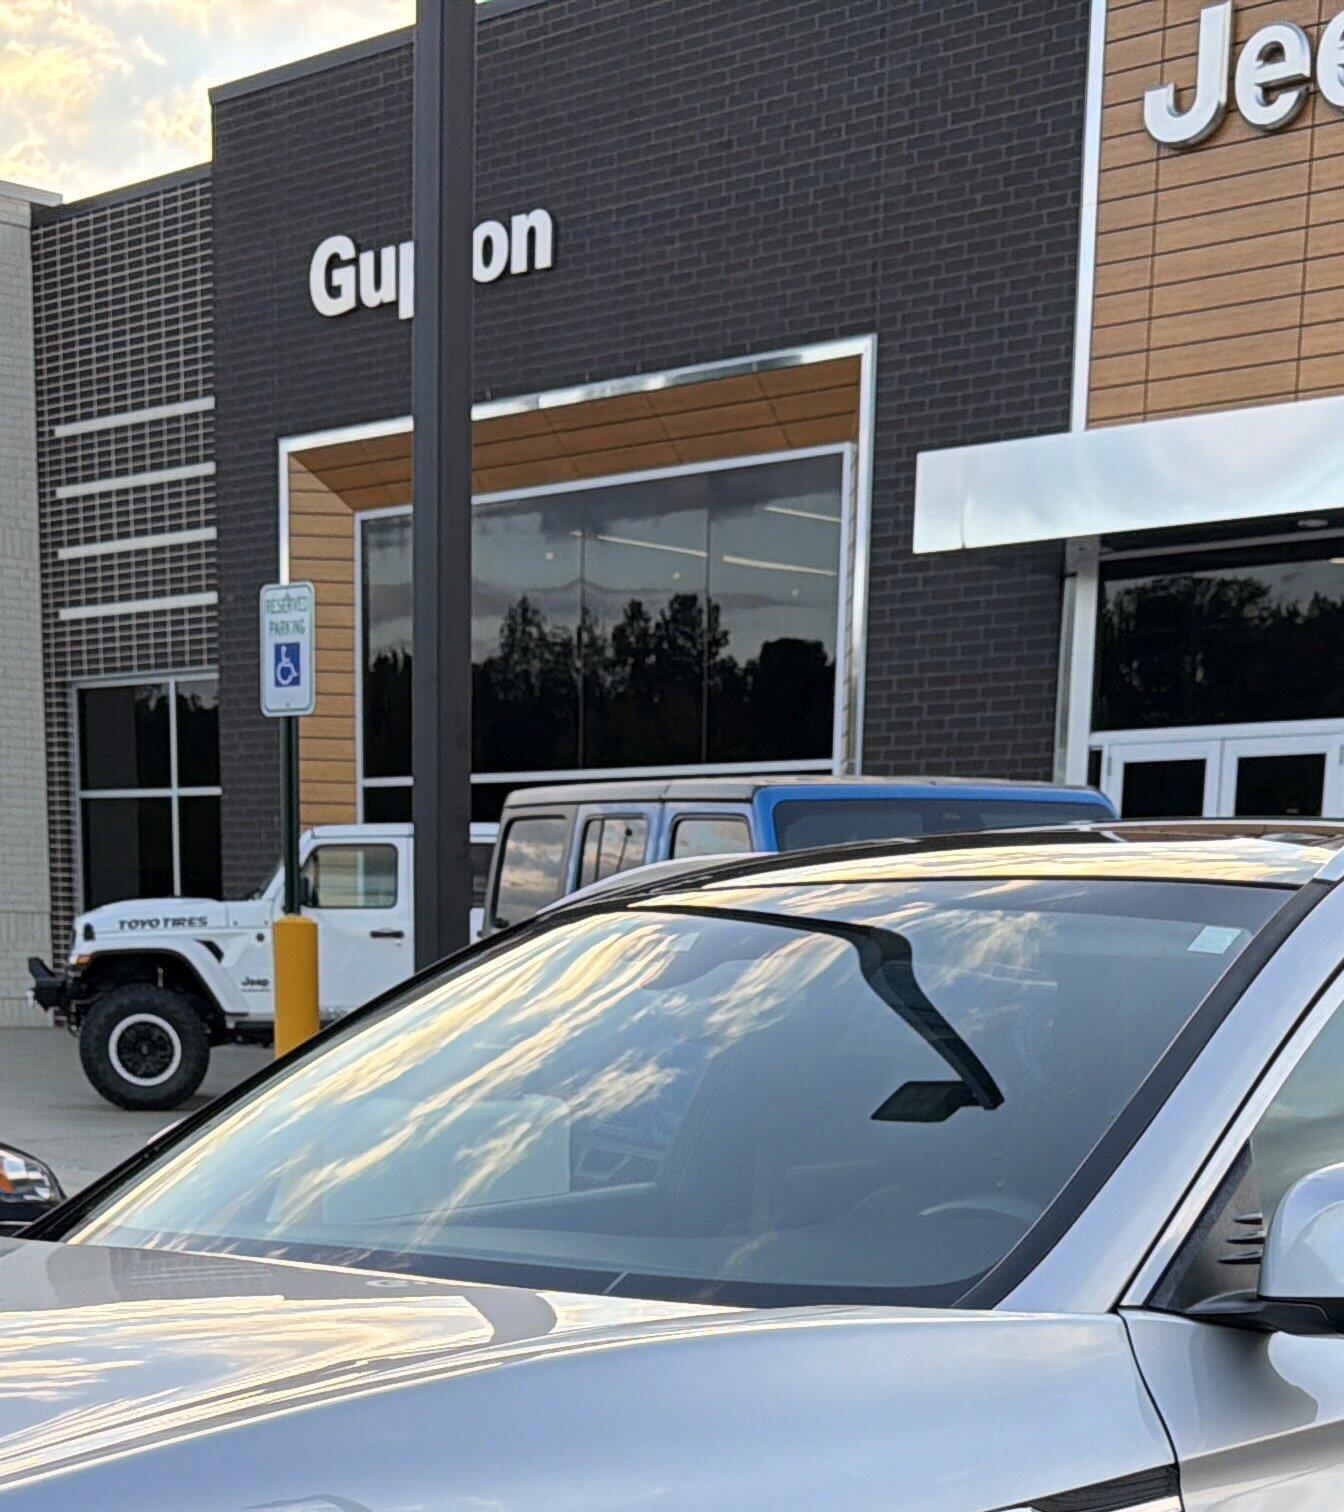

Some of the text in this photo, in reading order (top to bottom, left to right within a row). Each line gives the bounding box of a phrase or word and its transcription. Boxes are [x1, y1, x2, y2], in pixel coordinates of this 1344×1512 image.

[309, 208, 554, 320] Guon
[268, 618, 306, 636] PARKING
[118, 916, 209, 931] TOYO TIRES
